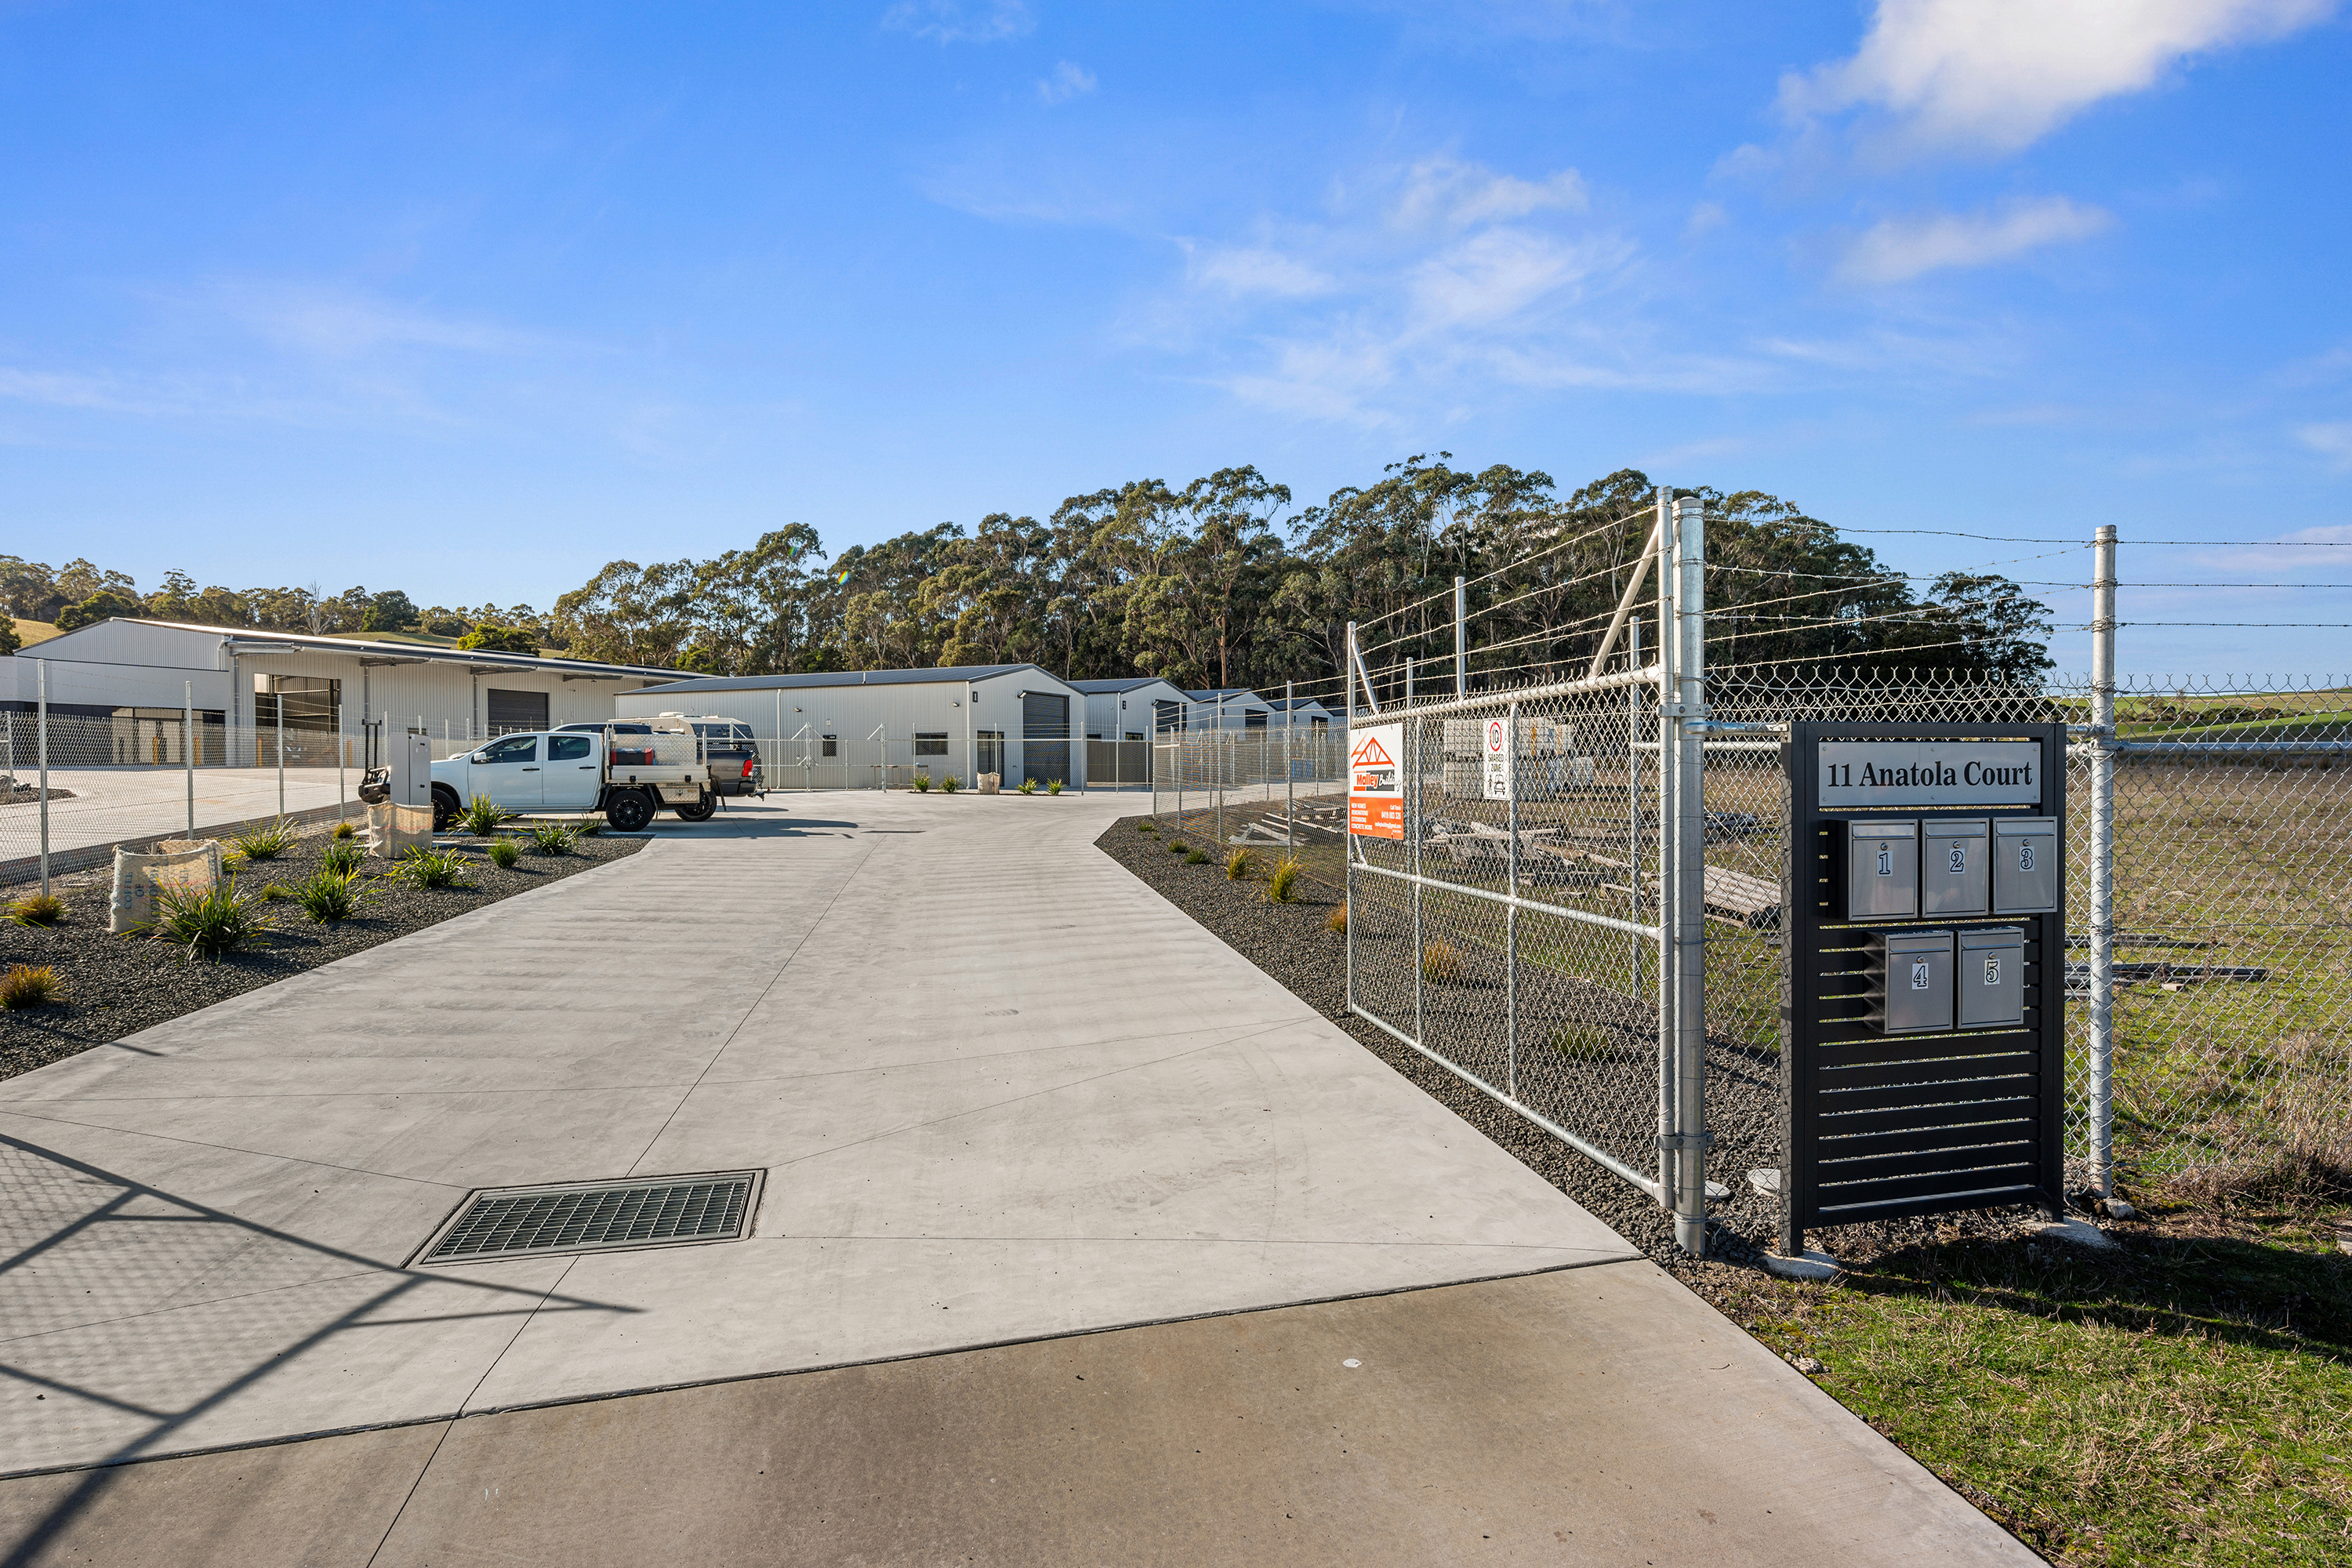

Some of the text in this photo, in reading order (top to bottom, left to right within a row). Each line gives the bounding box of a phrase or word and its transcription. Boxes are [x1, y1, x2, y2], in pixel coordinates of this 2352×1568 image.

[1492, 730, 1499, 744] 10
[1488, 753, 1504, 763] SHARED
[1491, 764, 1501, 772] ZONE
[1356, 773, 1378, 789] Malley
[1828, 760, 2033, 787] 11 Anatola Court
[1878, 852, 1891, 875] 1
[1951, 851, 1965, 873] 2
[2020, 848, 2034, 870] 3
[124, 871, 133, 909] COFFEE
[136, 883, 144, 898] OF
[1914, 965, 1928, 987] 4
[1986, 961, 1999, 983] 5
